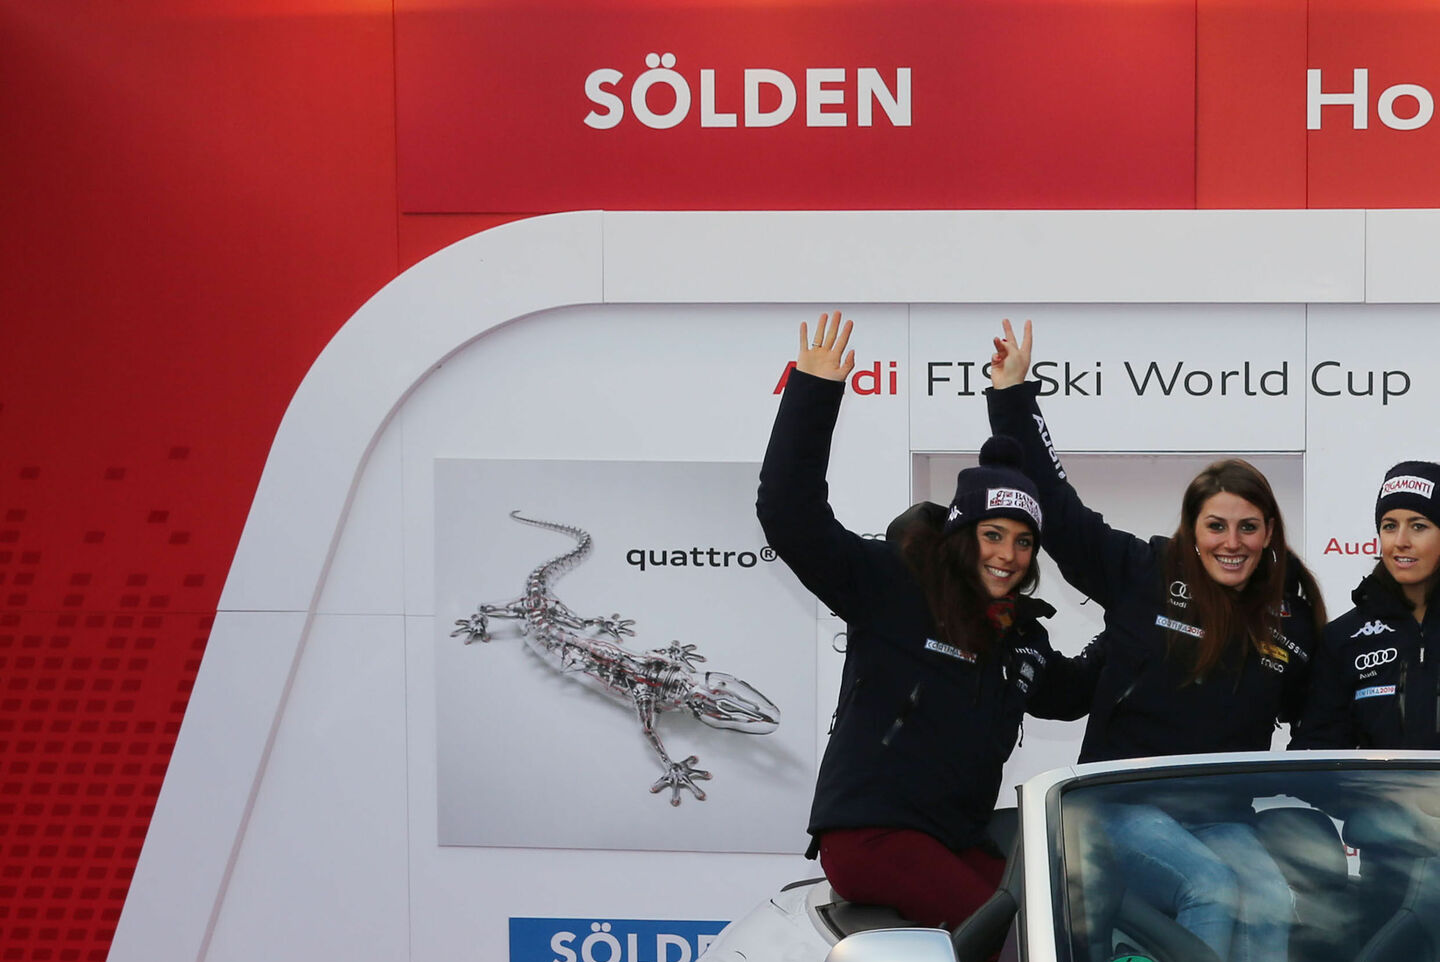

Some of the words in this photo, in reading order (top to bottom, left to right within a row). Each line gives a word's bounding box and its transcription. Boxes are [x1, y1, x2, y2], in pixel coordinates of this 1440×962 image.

[583, 52, 912, 130] SÖLDEN
[1031, 361, 1102, 396] Ski
[1123, 361, 1289, 397] World
[1310, 361, 1411, 405] Cup
[1384, 479, 1431, 494] RIGAMONTI
[1323, 538, 1378, 555] Aud
